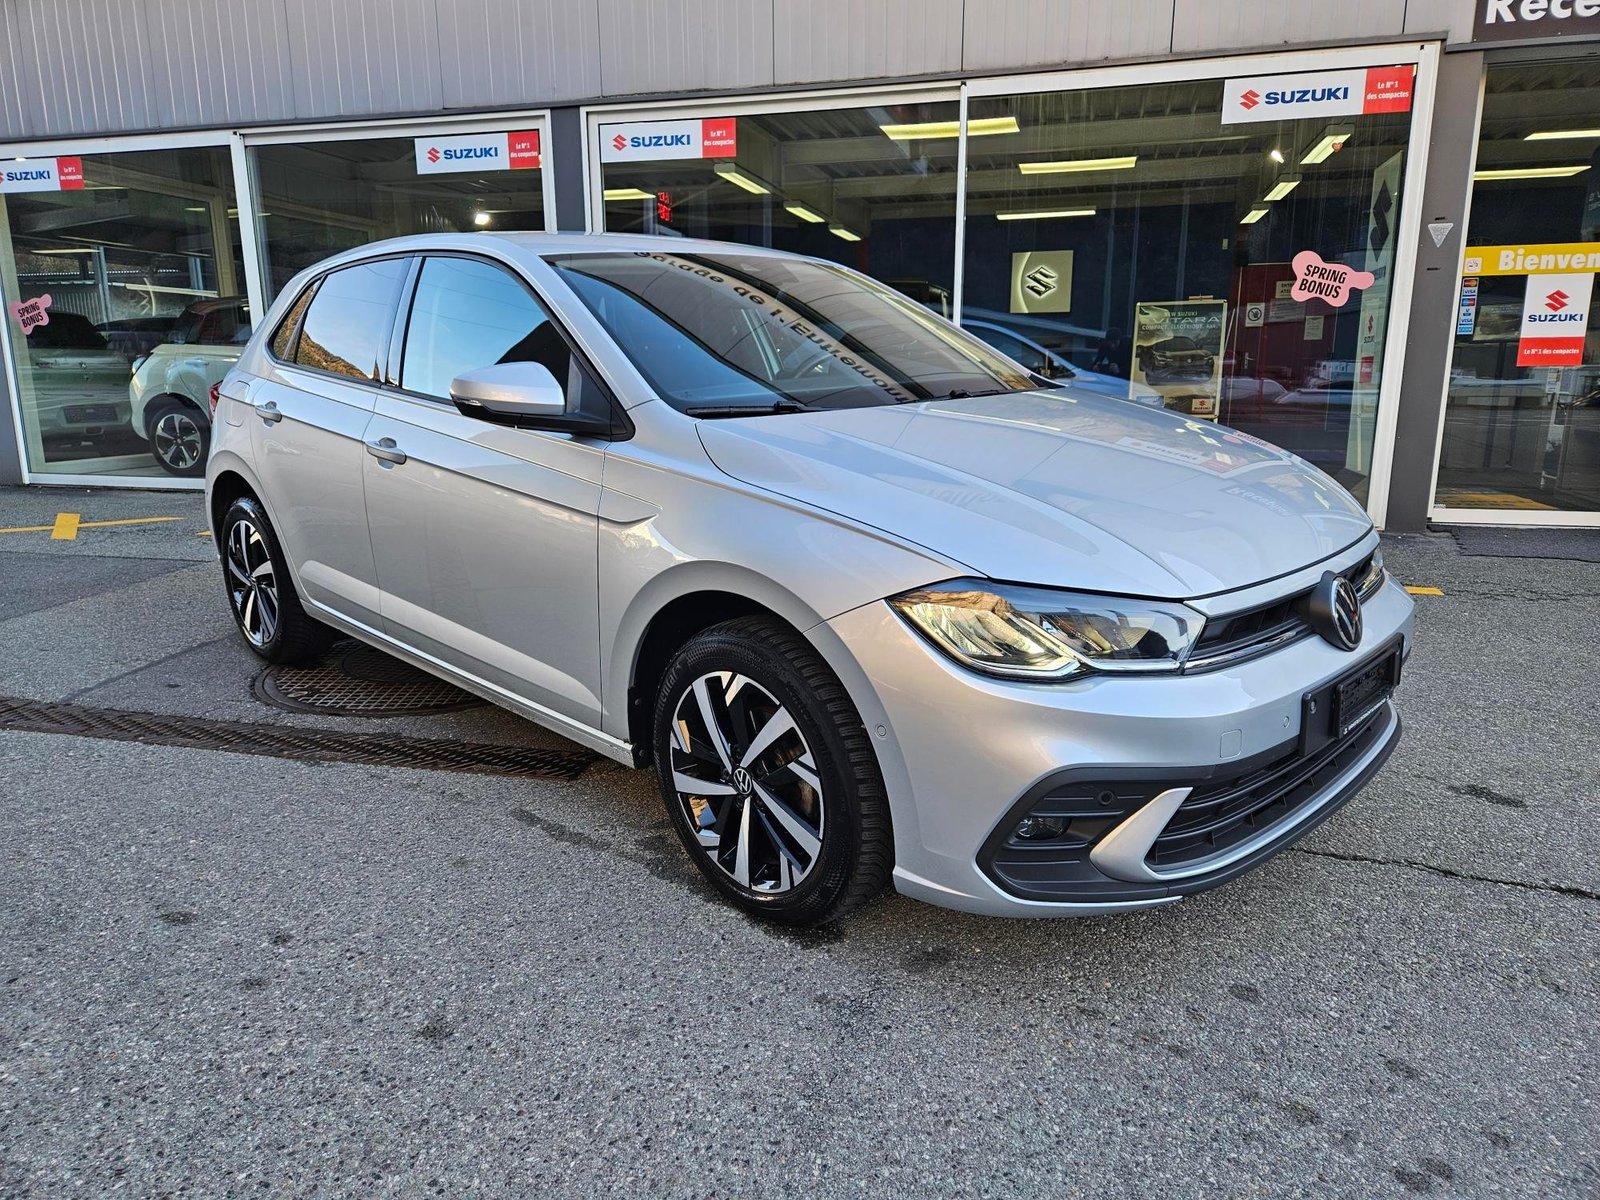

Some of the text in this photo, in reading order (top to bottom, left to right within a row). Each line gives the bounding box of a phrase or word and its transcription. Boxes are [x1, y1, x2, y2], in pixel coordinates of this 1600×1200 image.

[1377, 81, 1385, 89] Le
[1265, 87, 1349, 105] SUZUKI
[1366, 91, 1409, 100] des compactes
[630, 134, 690, 148] SUZUKI
[443, 147, 498, 160] SUZUKI
[6, 170, 51, 181] SUZUKI
[1498, 248, 1600, 271] Bienven
[1304, 264, 1348, 284] SPRING
[1299, 278, 1342, 299] BONUS
[18, 301, 40, 318] SPRING
[21, 312, 44, 328] BONUS
[1153, 316, 1220, 324] VITARA
[1528, 313, 1584, 323] SUZUKI
